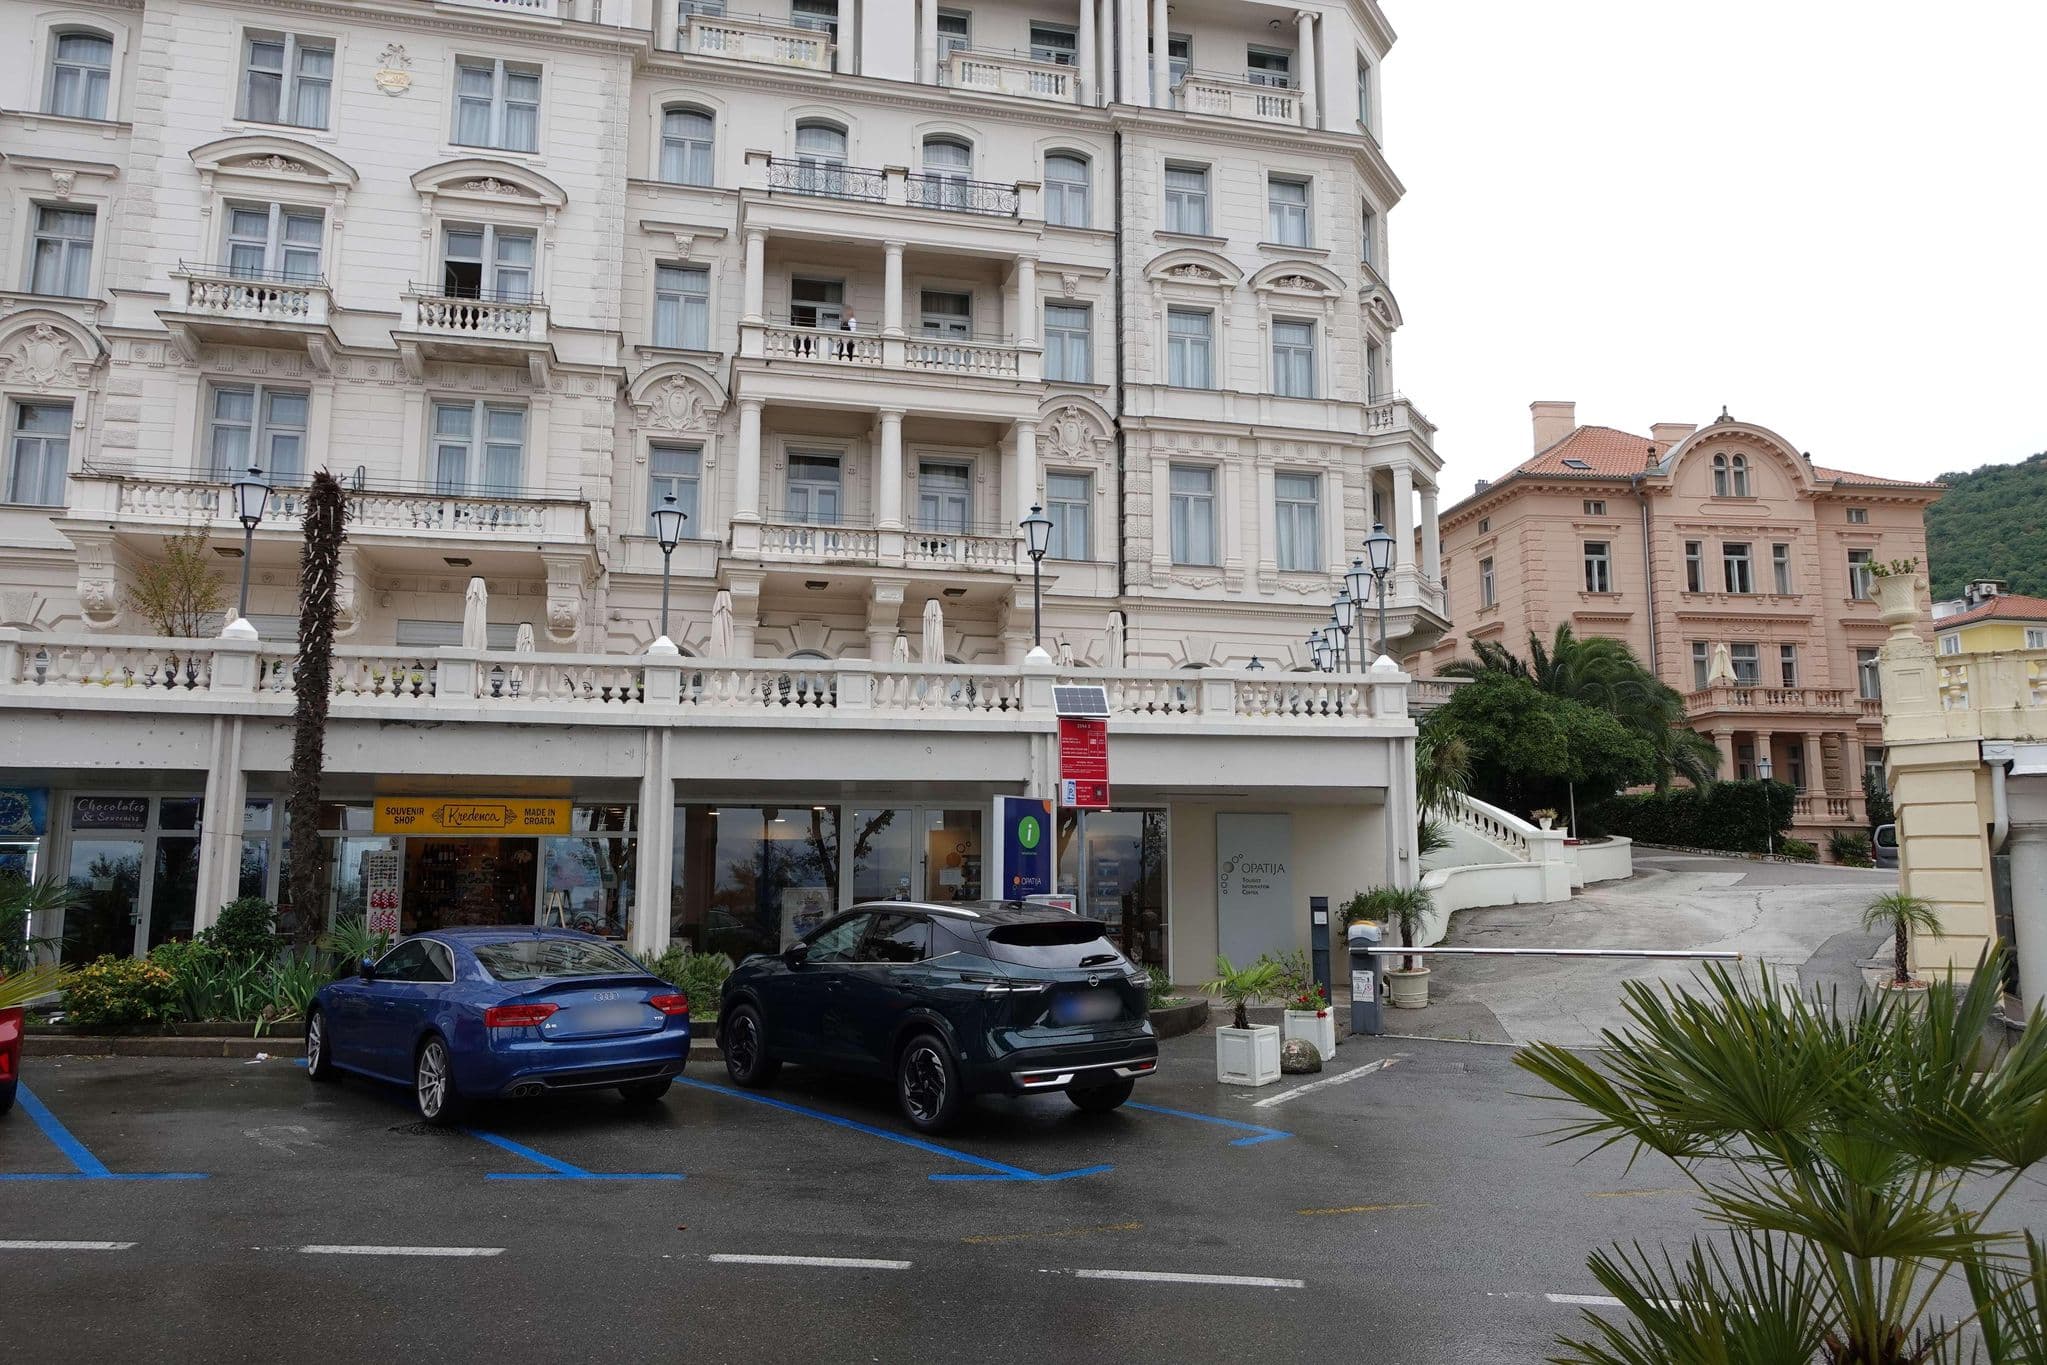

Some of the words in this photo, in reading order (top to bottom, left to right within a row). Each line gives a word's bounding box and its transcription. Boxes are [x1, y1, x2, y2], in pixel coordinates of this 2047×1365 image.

[77, 798, 145, 813] Chocolates
[385, 806, 424, 816] SOUVENIR
[524, 807, 545, 817] MADE
[547, 808, 556, 817] IN
[81, 812, 95, 822] &
[394, 816, 416, 825] SHOP
[448, 807, 500, 826] Kredenca
[524, 816, 555, 826] CROATIA
[1241, 863, 1285, 875] OPATIJA
